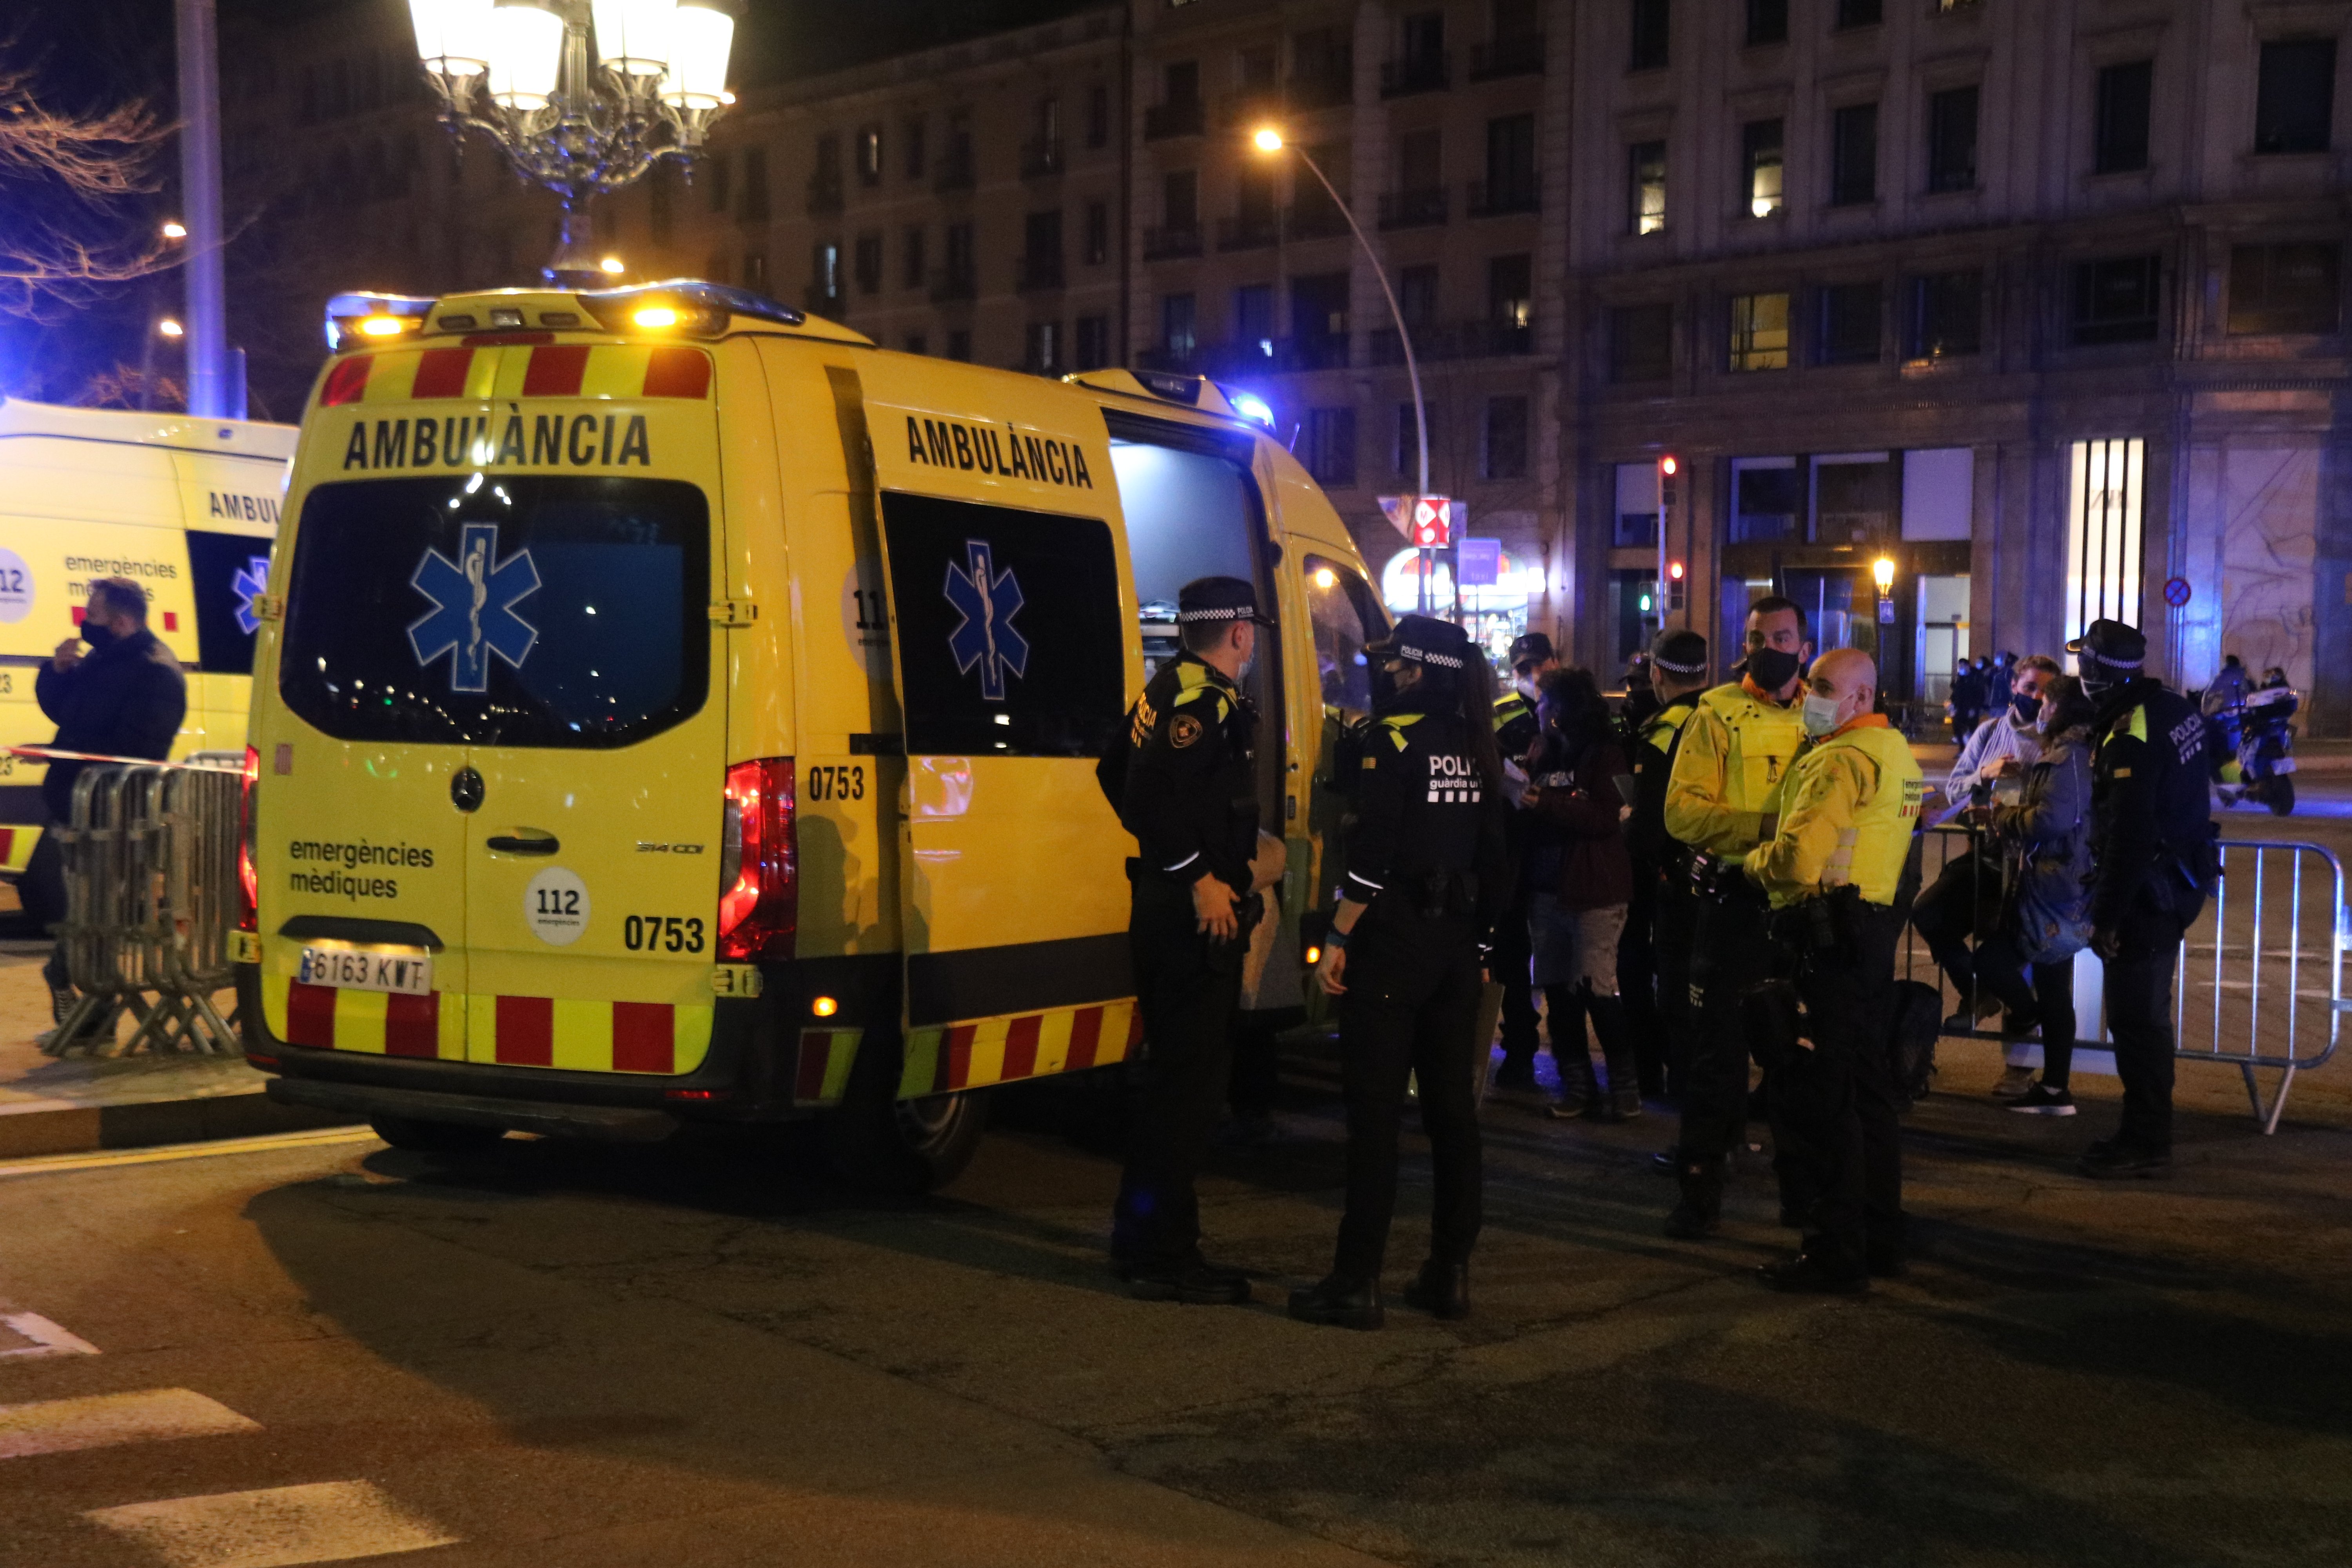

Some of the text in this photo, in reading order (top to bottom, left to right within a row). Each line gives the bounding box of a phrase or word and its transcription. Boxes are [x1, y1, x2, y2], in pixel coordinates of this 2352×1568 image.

[343, 403, 651, 470] AMBULÀNCIA
[906, 416, 1093, 490] AMBULÀNCIA
[65, 556, 177, 578] emergències
[809, 766, 864, 801] 0753
[1430, 778, 1468, 790] guàrdia
[290, 838, 434, 869] emergències
[290, 868, 397, 902] mèdiques
[537, 889, 580, 915] 112
[625, 915, 704, 953] 0753
[314, 953, 368, 983] 6163
